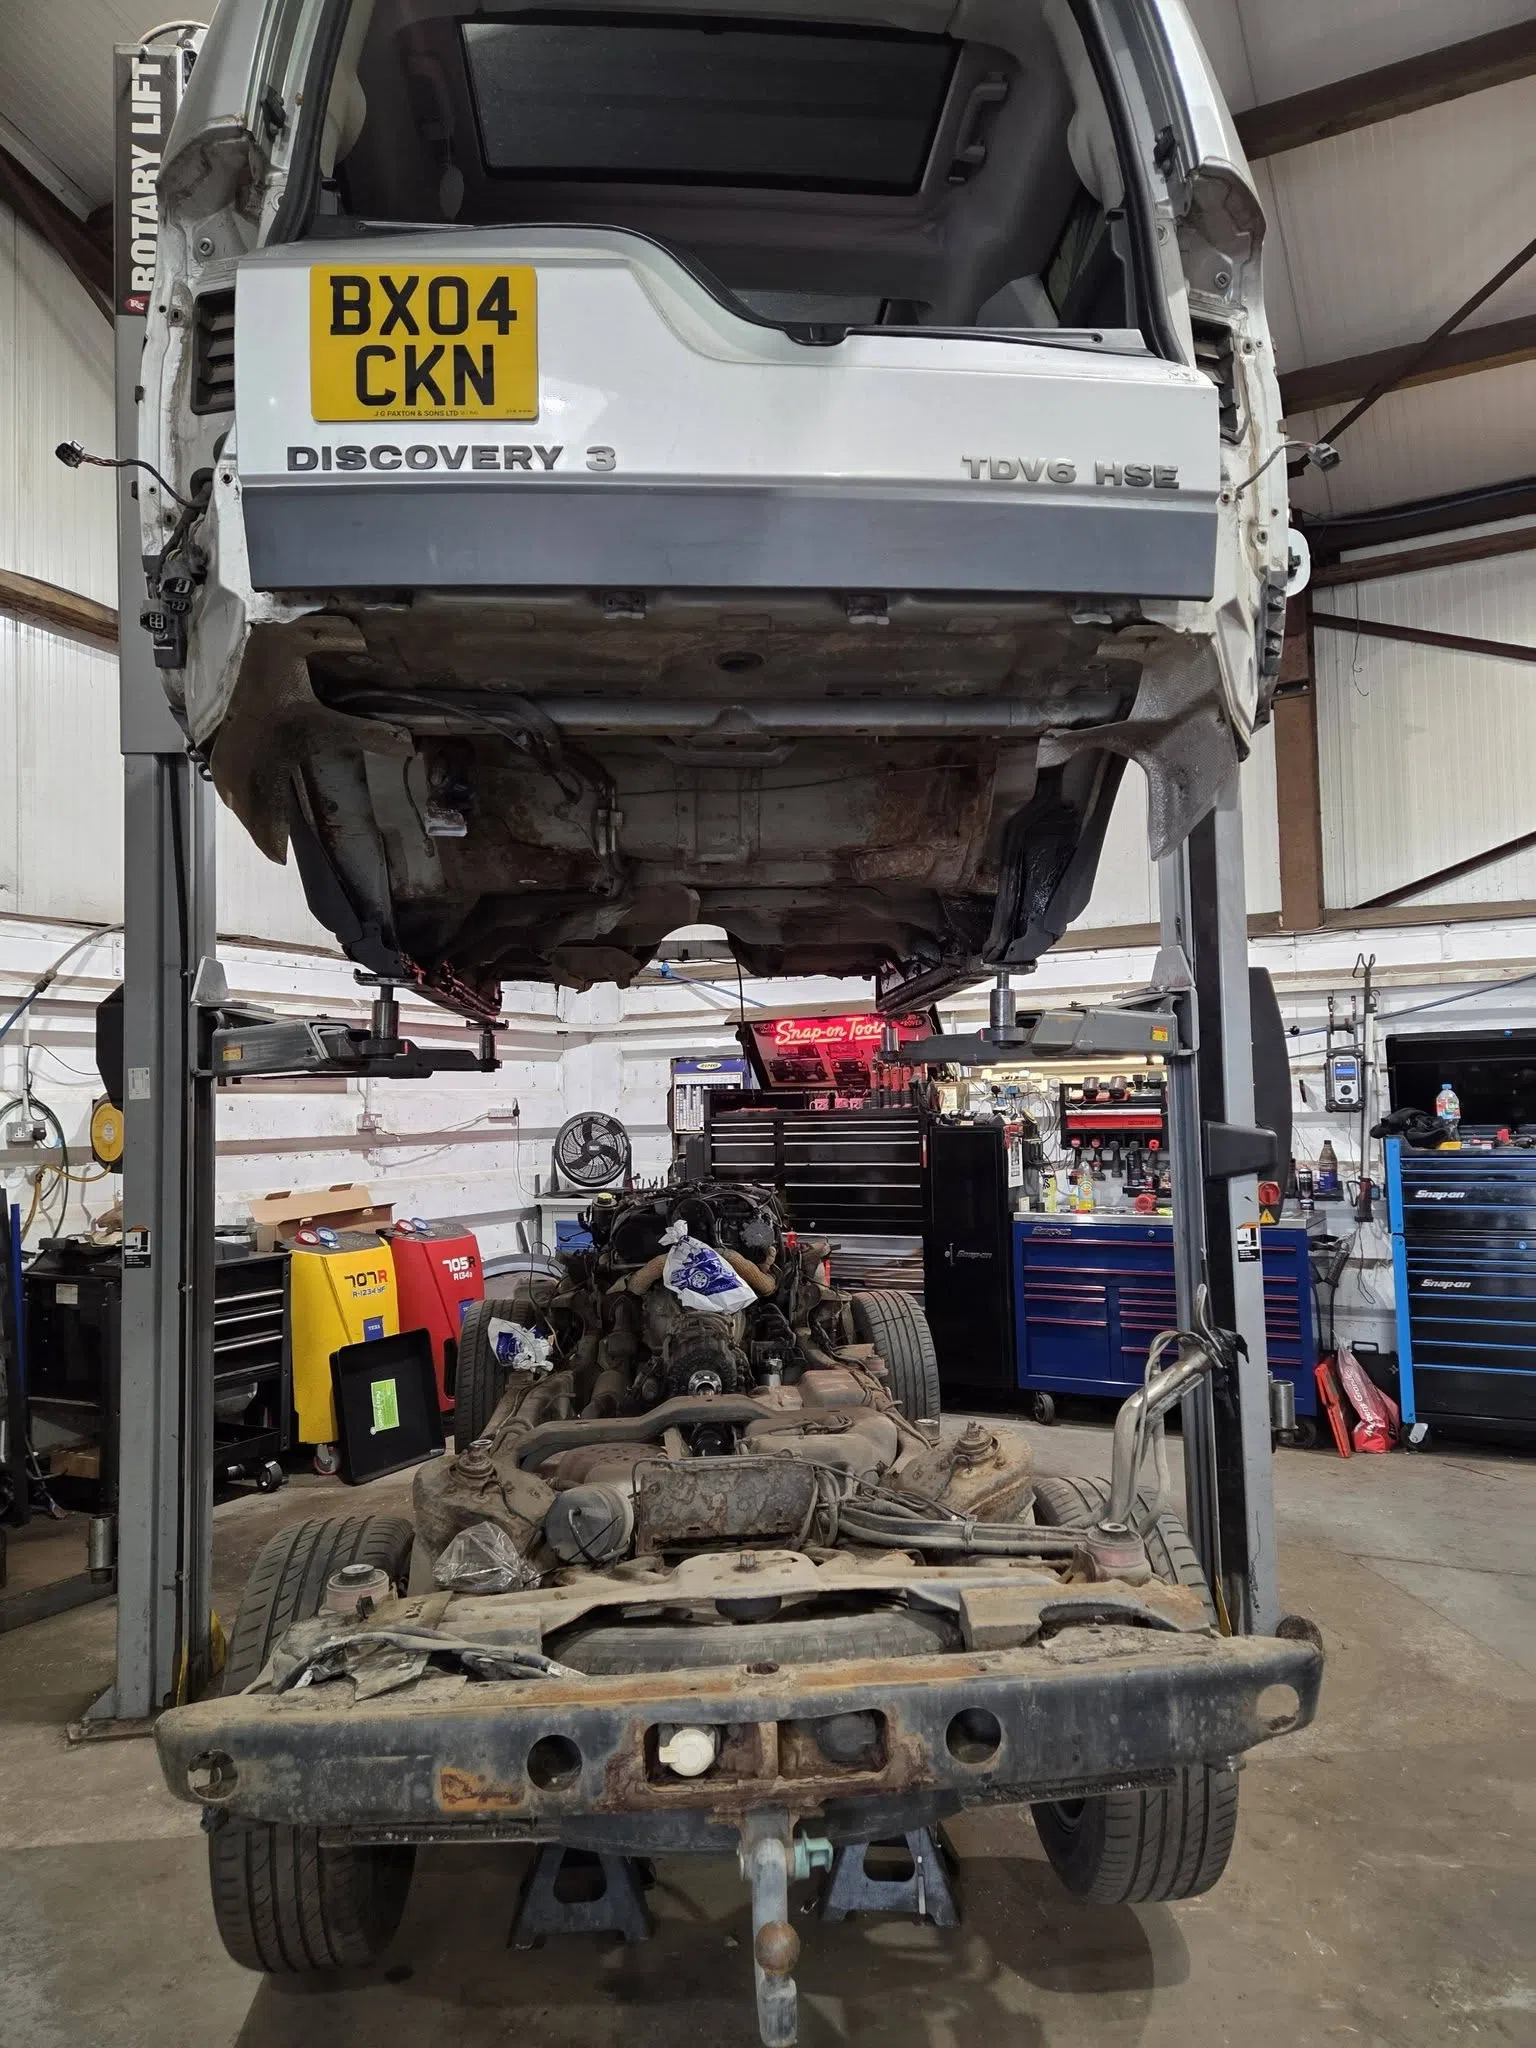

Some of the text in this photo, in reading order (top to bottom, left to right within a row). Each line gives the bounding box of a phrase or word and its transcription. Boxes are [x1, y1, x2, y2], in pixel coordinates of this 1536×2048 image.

[131, 57, 161, 134] LIFT
[131, 144, 160, 291] ROTARY
[329, 275, 518, 336] BX04
[355, 344, 496, 407] CKN
[286, 444, 617, 472] DISCOVERY 3
[961, 454, 1180, 490] TDV6 HSE
[775, 1019, 846, 1045] Snap-on
[1415, 1189, 1466, 1201] Snap-on
[442, 1255, 477, 1273] 705R
[344, 1269, 388, 1288] 707R
[1421, 1278, 1472, 1290] Snap-on
